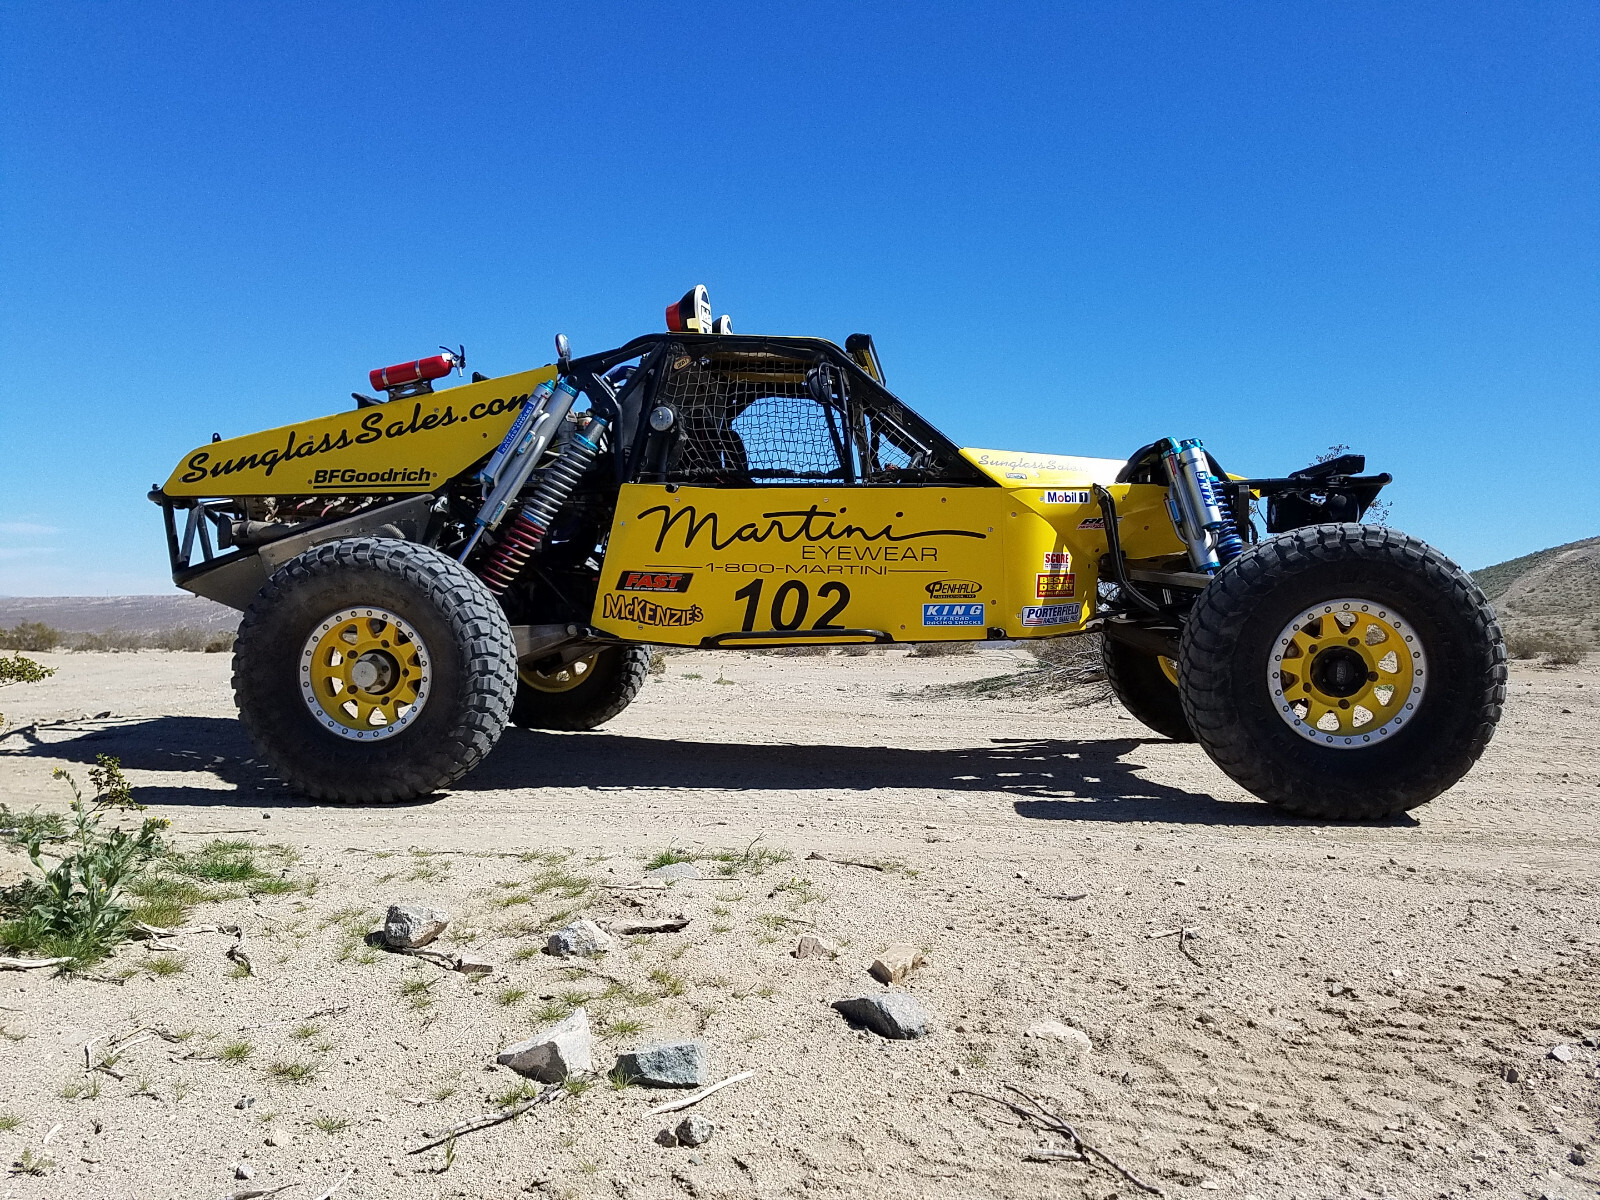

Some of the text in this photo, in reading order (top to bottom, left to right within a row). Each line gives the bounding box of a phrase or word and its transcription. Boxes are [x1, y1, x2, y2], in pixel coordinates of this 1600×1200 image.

[314, 467, 428, 487] BFGoodrich
[1047, 491, 1077, 503] Mobil
[1196, 472, 1213, 507] KING
[638, 505, 986, 553] Martini
[803, 546, 937, 562] EYEWEAR
[1045, 553, 1069, 563] SCORE
[706, 562, 887, 576] 1-800-MARTINI
[625, 574, 682, 589] FAST
[925, 580, 982, 599] PENHALL
[735, 578, 850, 632] 102
[926, 605, 982, 615] KING
[1027, 605, 1080, 619] PORTERFIELD
